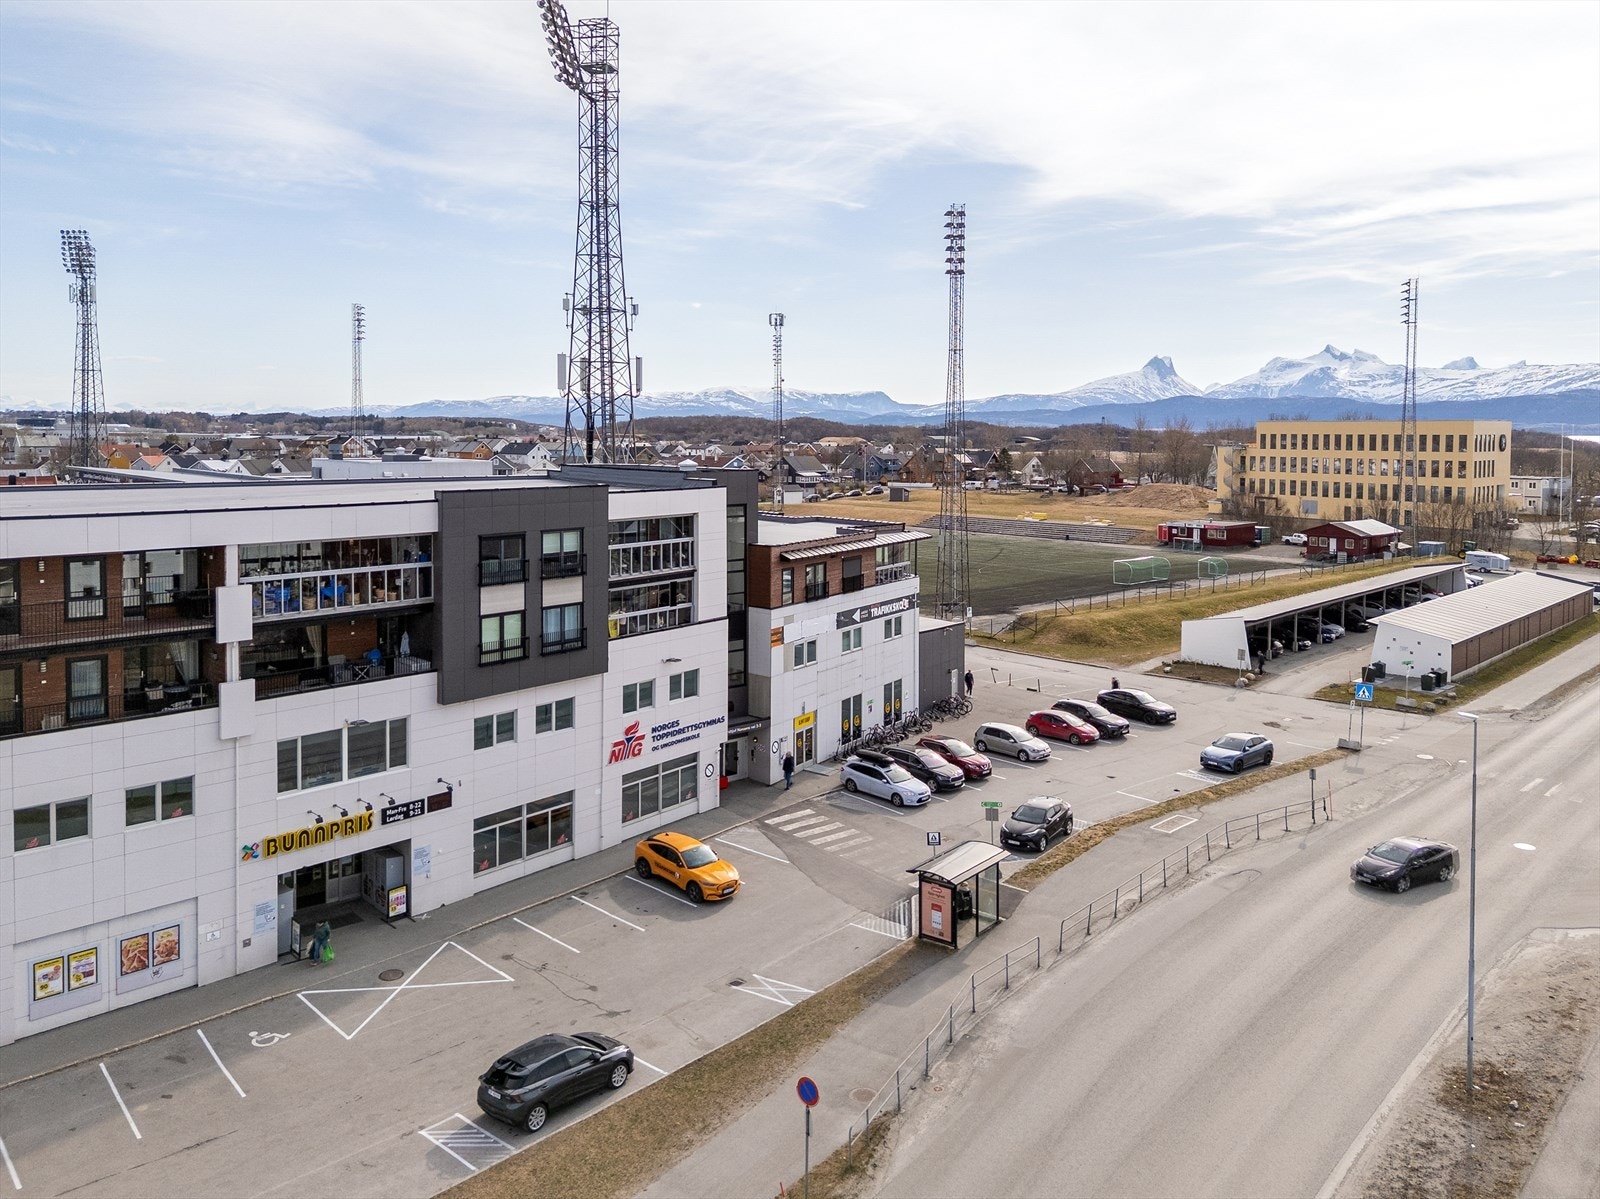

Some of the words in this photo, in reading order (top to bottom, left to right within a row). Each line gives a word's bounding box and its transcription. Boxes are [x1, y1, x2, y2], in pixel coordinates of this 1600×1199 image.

[651, 720, 680, 734] NORGES
[651, 716, 726, 742] TOPPIDRETTSGYMNAS
[660, 733, 701, 750] UNGDOMSSKOLE
[409, 802, 422, 810] 8-22
[264, 811, 374, 858] BUNNPRIS
